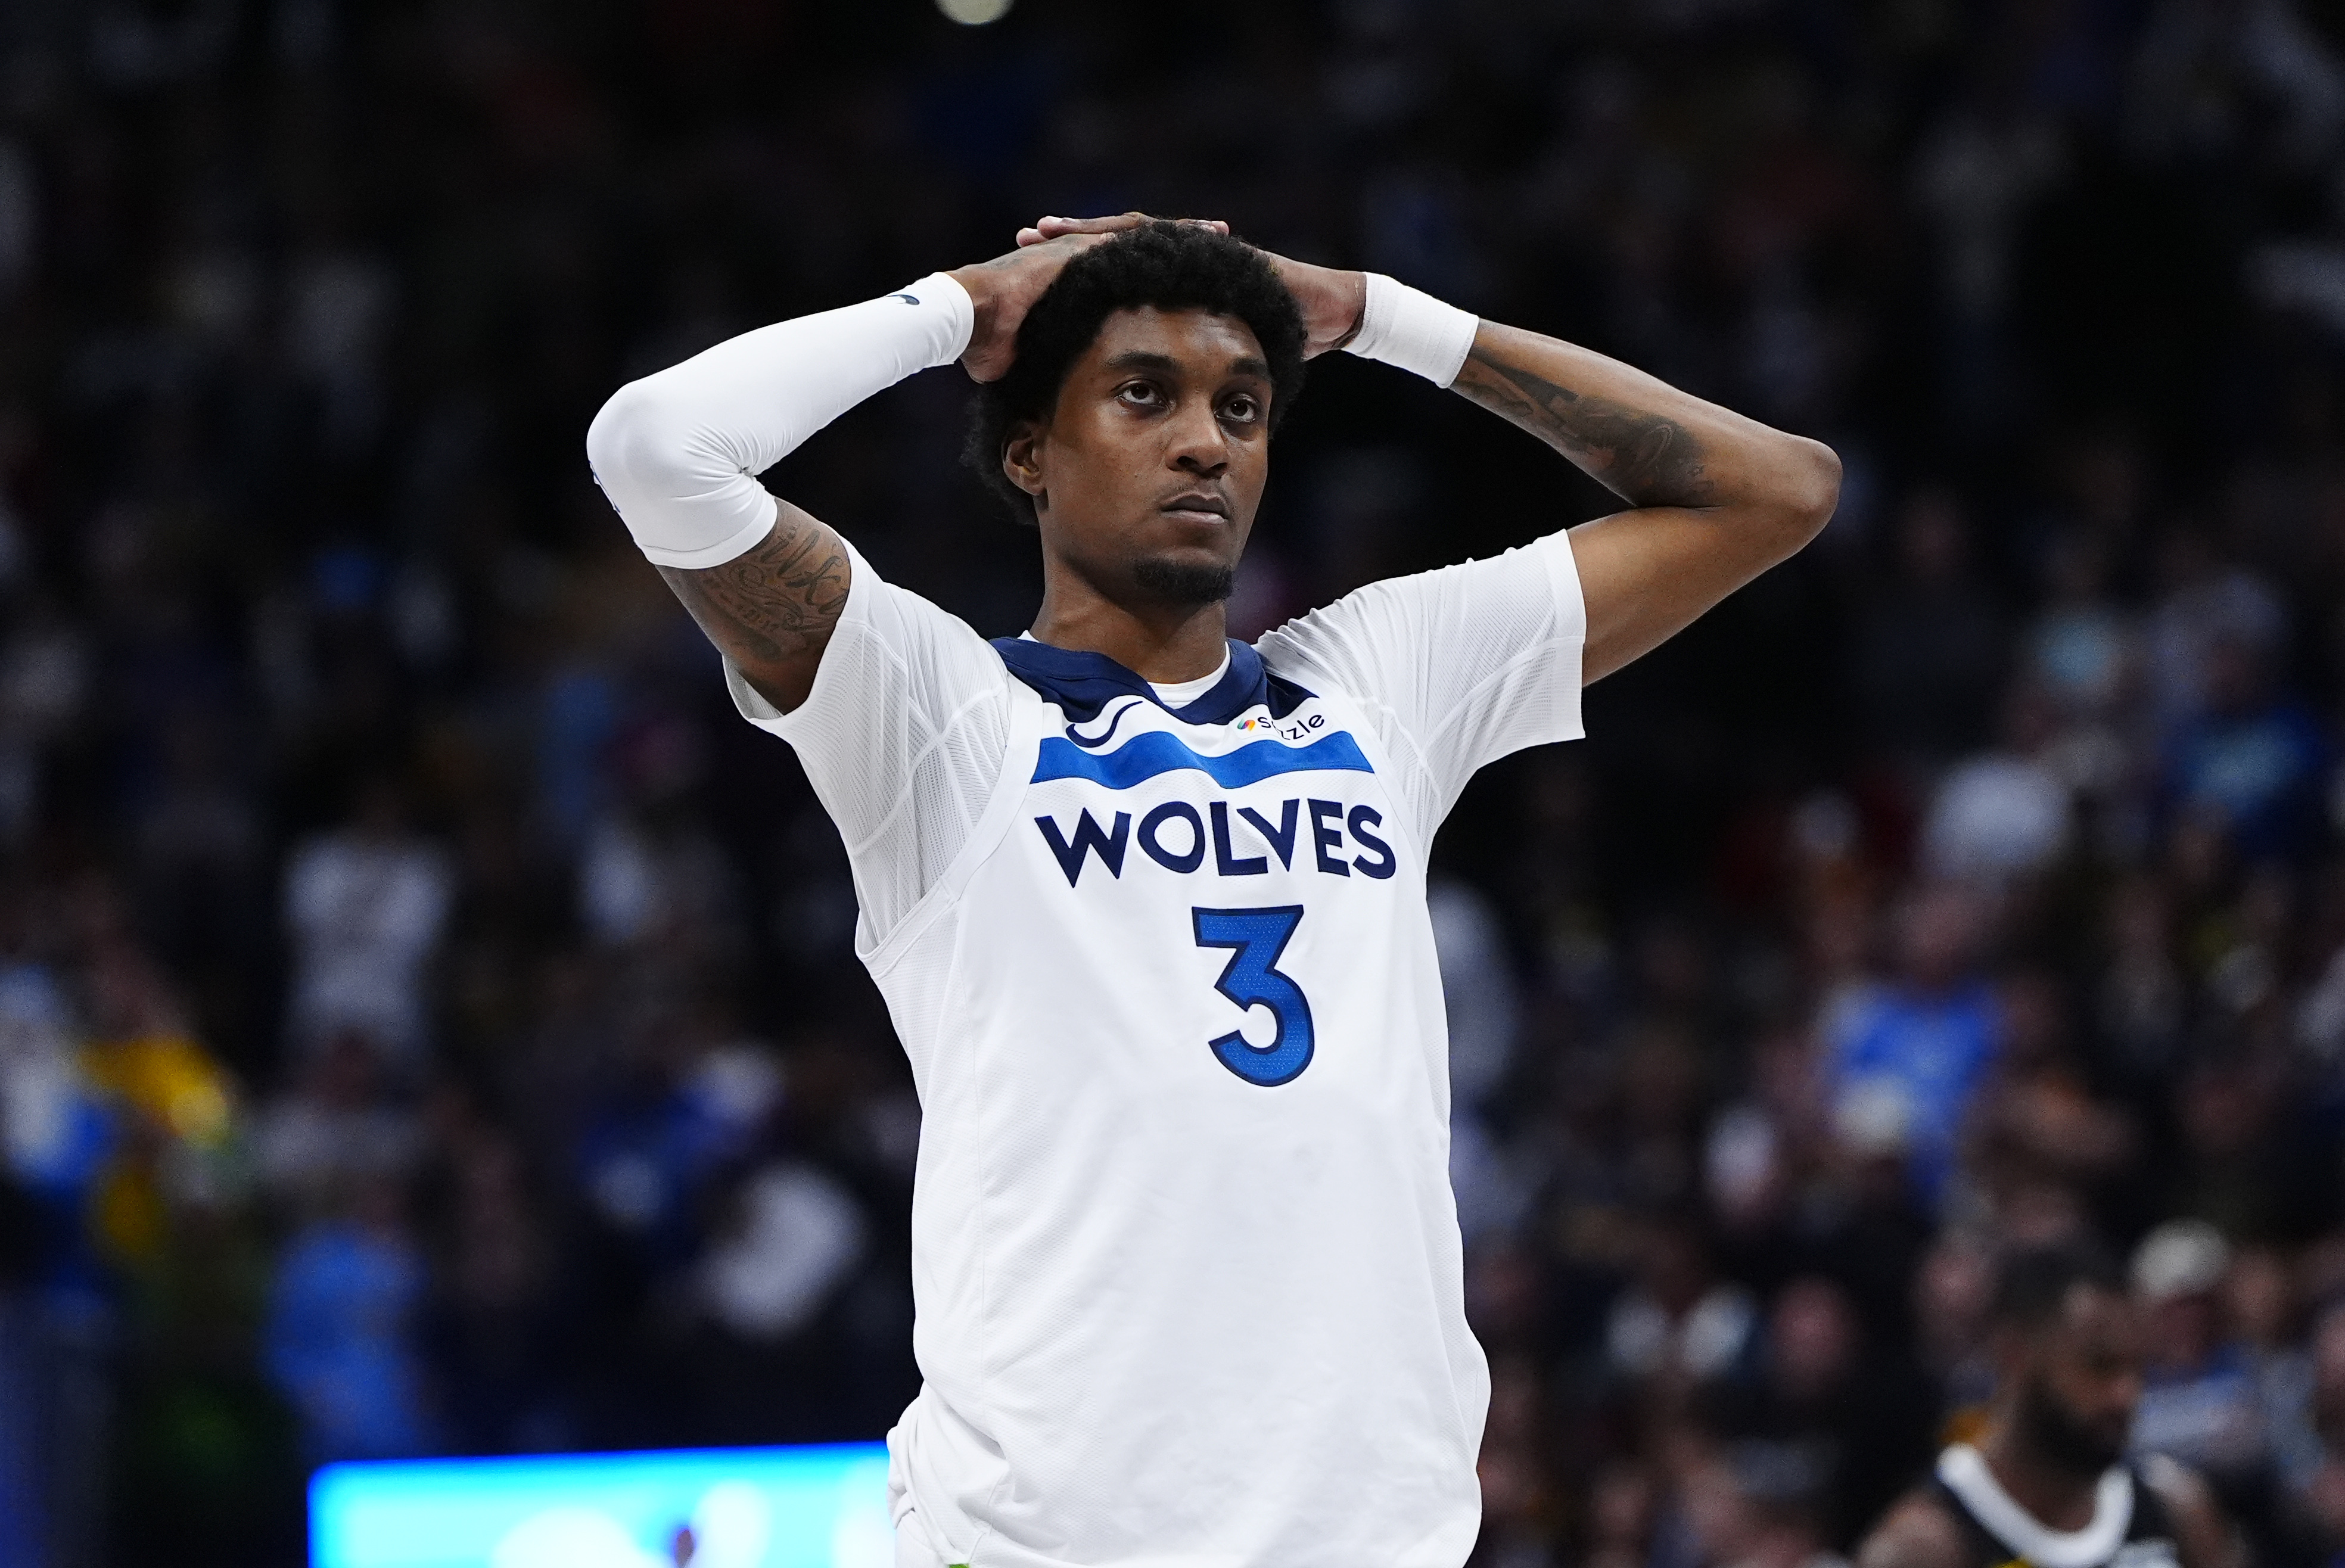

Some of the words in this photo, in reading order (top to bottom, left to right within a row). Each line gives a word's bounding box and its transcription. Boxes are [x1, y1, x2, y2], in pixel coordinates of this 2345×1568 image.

[1257, 714, 1325, 740] szzle
[1034, 798, 1397, 889] WOLVES
[1192, 904, 1315, 1087] 3
